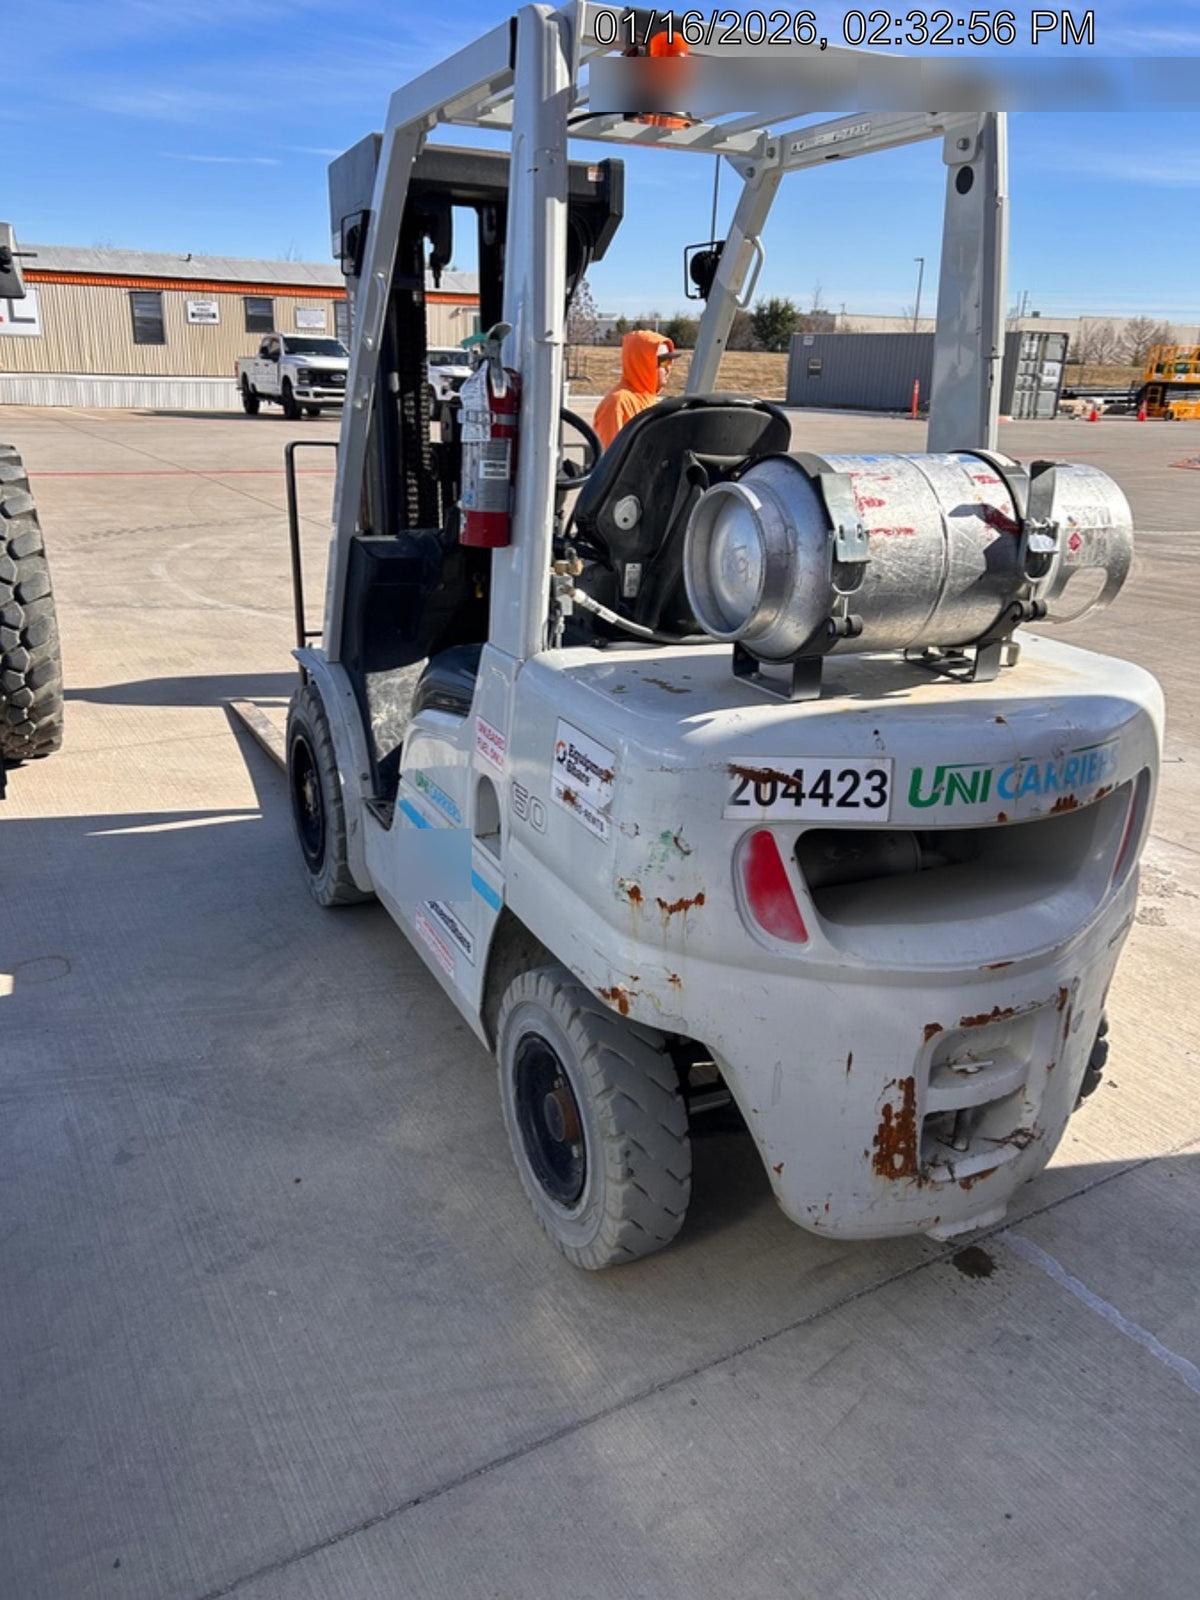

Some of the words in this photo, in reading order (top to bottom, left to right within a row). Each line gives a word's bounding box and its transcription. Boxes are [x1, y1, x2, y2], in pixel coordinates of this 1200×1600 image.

[566, 758, 590, 786] Share
[568, 742, 614, 784] Equipme
[728, 766, 888, 809] 204423
